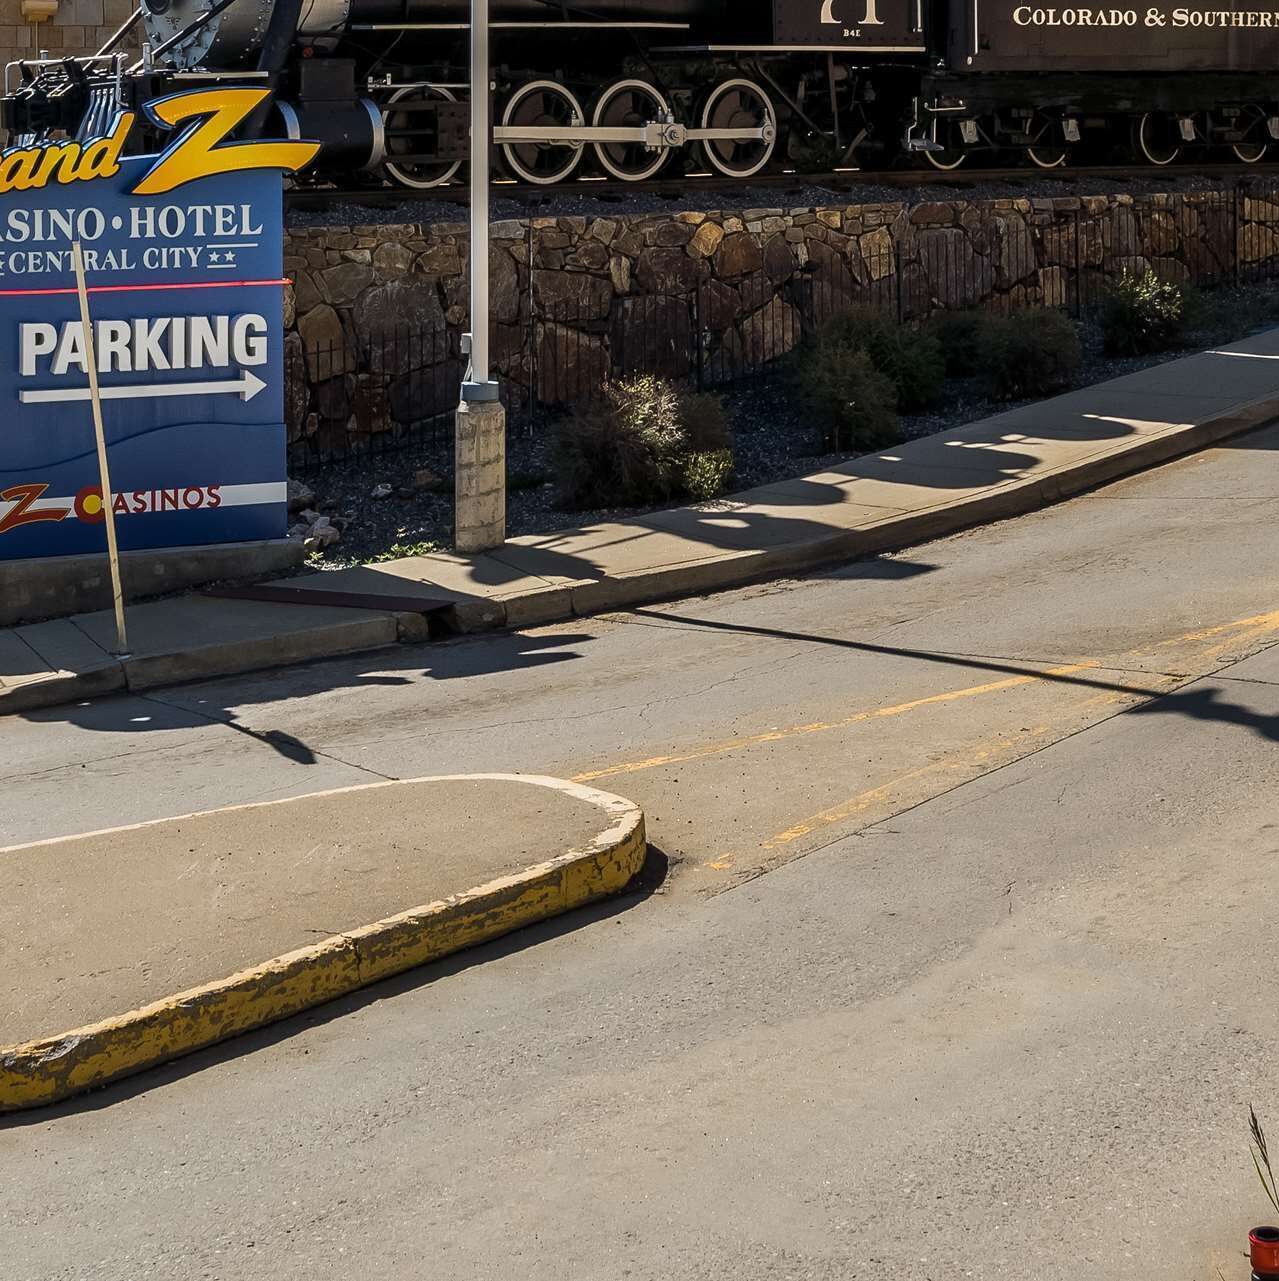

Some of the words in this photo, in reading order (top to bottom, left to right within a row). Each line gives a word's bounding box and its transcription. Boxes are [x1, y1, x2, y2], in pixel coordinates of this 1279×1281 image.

[843, 29, 861, 37] B4E
[1013, 6, 1137, 26] COLORADO
[1144, 7, 1167, 27] &
[130, 88, 322, 195] Z
[129, 204, 264, 239] HOTEL
[142, 246, 204, 270] CITY
[19, 313, 268, 376] PARKING
[74, 485, 222, 523] CASINOS
